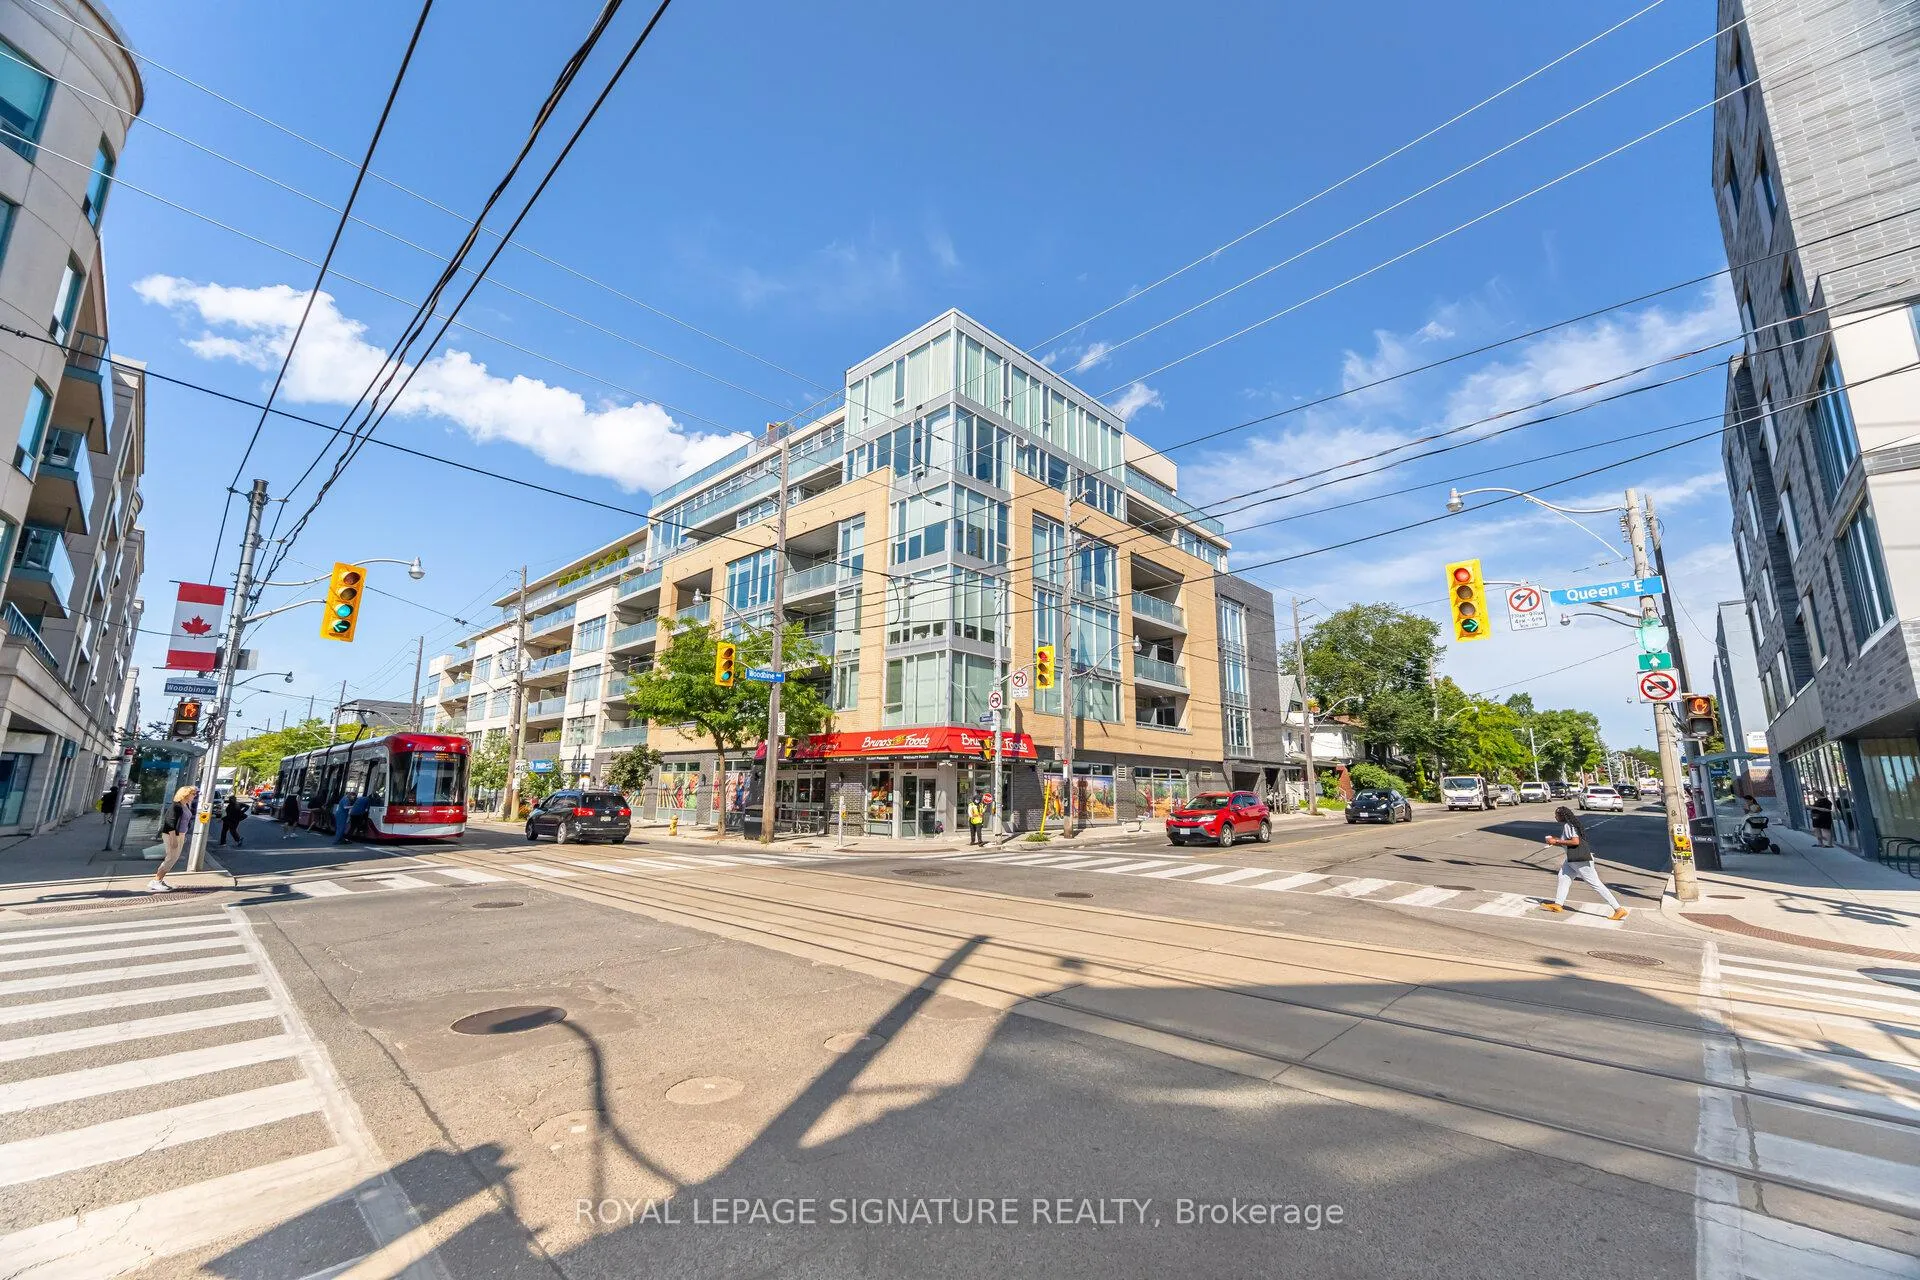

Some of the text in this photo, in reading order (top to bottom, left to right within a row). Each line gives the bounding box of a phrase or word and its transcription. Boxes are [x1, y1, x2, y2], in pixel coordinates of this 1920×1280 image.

[1566, 586, 1618, 602] Queen
[1633, 580, 1644, 593] E
[749, 669, 775, 679] Woodbine
[167, 683, 206, 693] Woodbine
[861, 736, 893, 748] Bruno's
[904, 733, 931, 747] Foods
[1004, 737, 1028, 750] Foods
